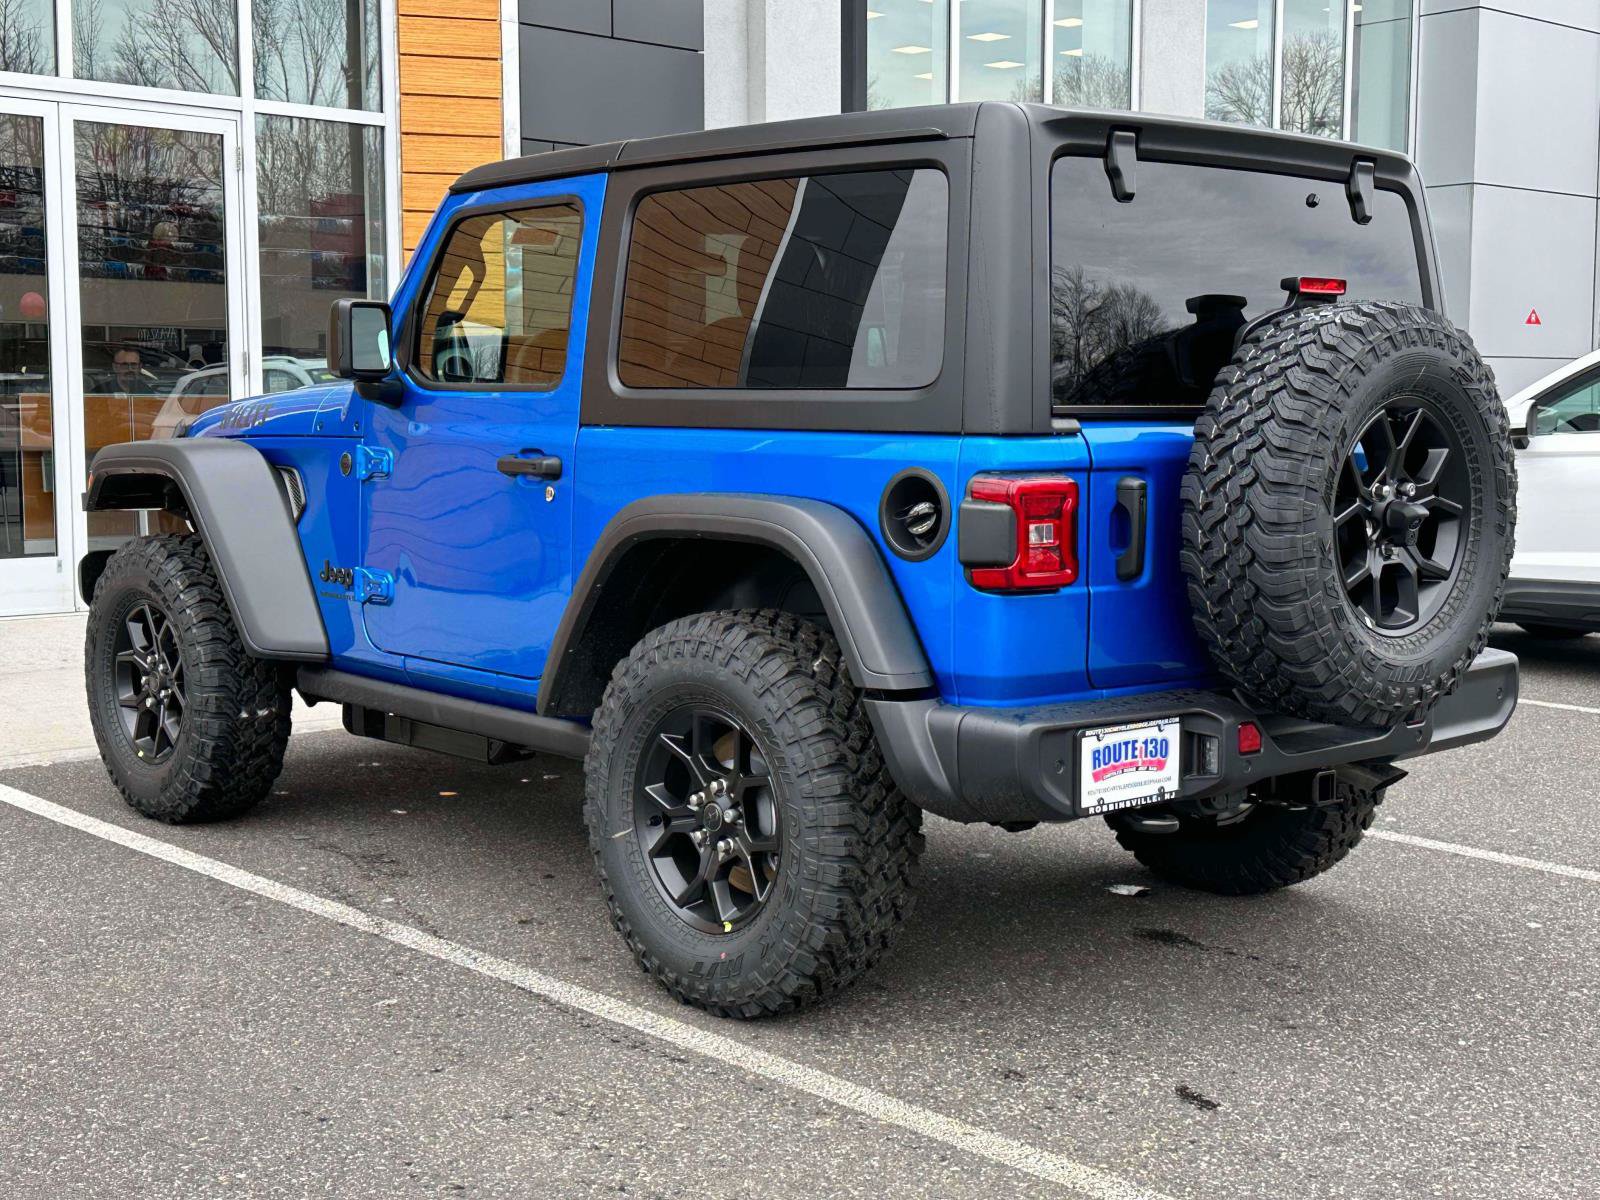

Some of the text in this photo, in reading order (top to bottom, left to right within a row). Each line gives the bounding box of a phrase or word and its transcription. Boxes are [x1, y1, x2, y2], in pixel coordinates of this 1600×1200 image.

[320, 560, 353, 590] Jeep
[1092, 738, 1169, 771] ROUTE 130
